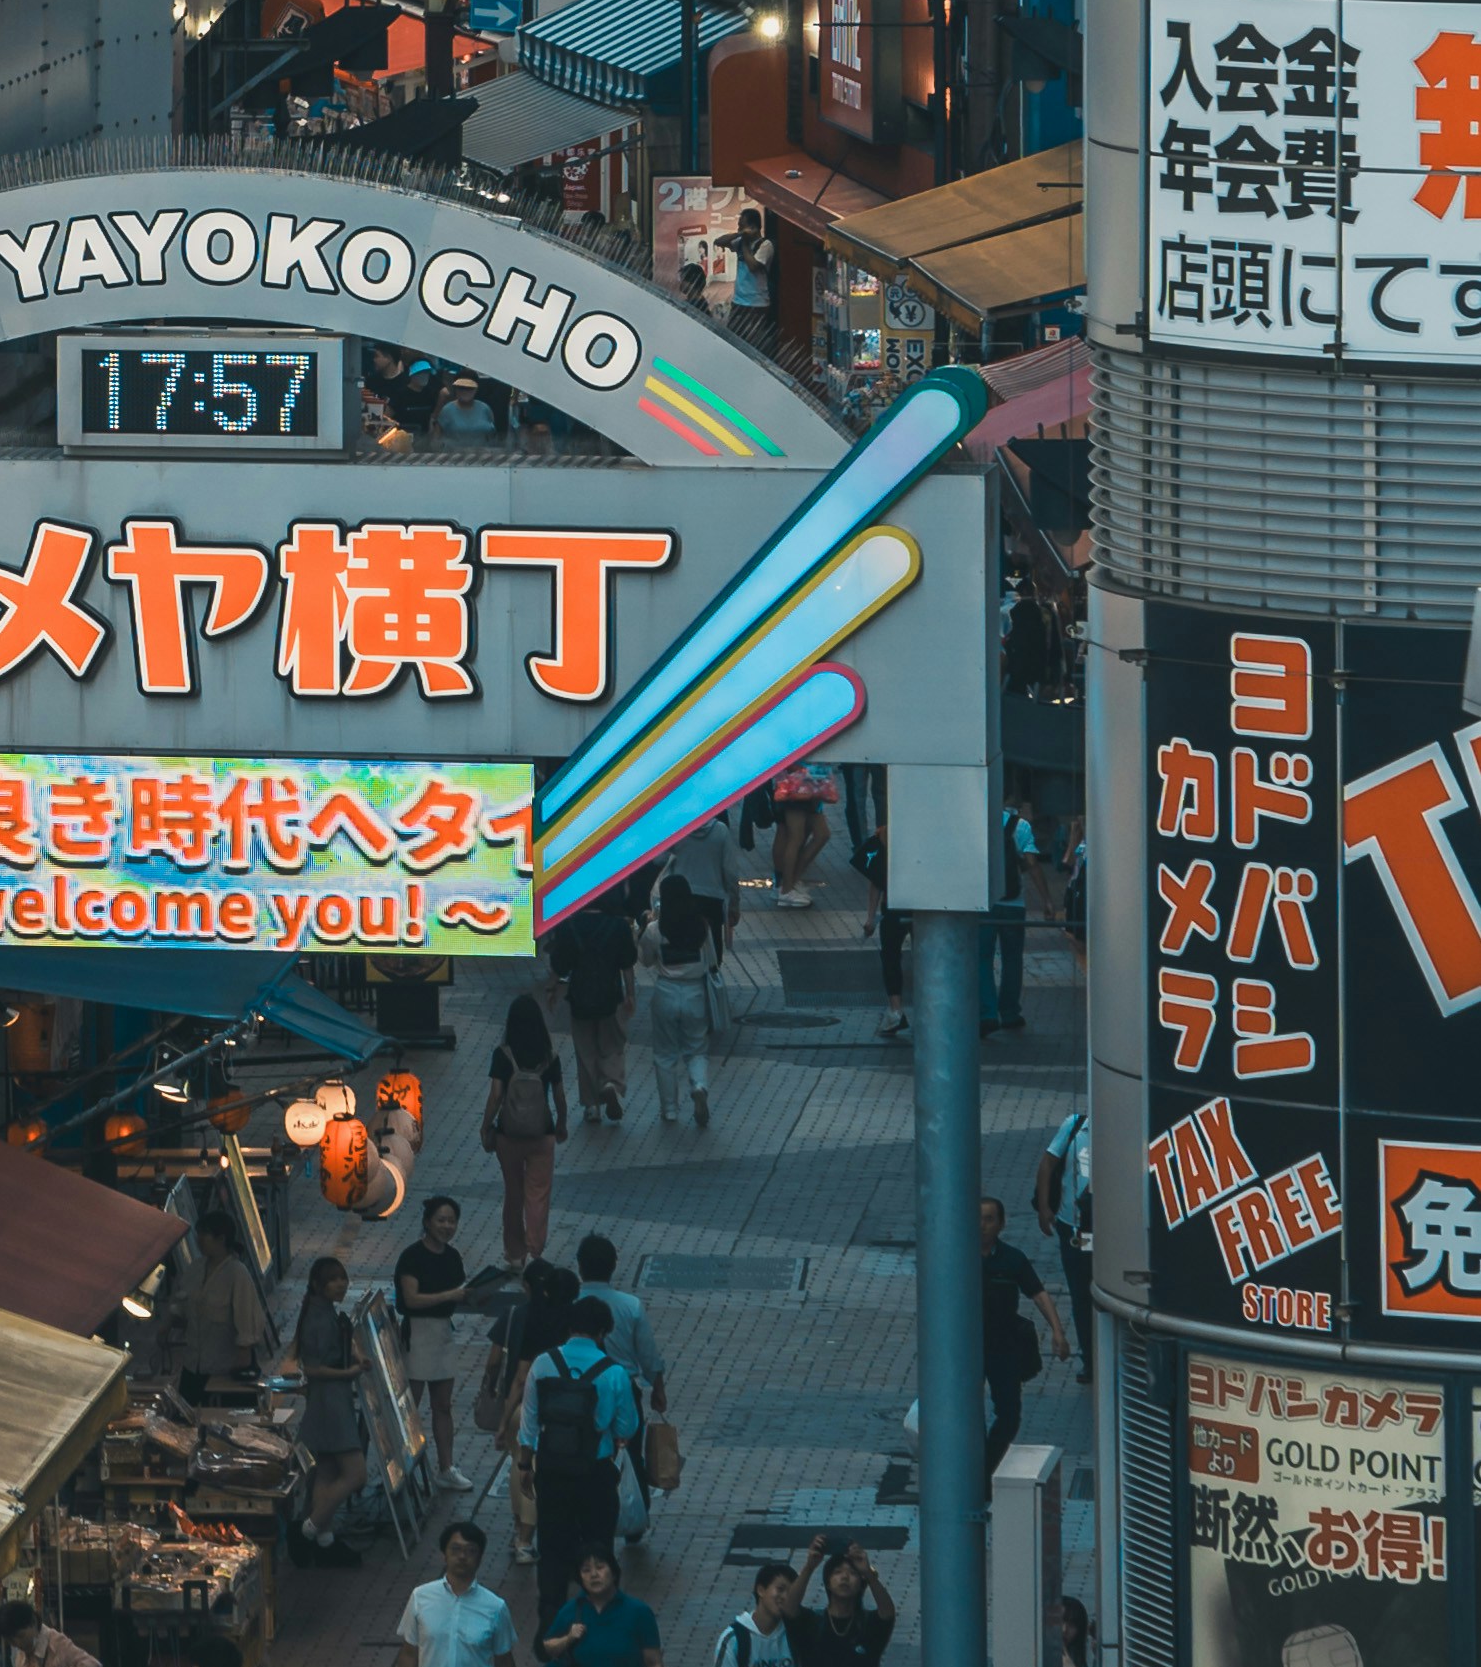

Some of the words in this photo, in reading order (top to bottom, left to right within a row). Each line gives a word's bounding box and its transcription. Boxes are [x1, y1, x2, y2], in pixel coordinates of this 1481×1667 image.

[1159, 20, 1362, 119] 入会金
[1159, 119, 1361, 225] 年会費
[97, 351, 312, 432] 17:57
[1226, 631, 1319, 1080] ヨドバシ
[270, 882, 425, 950] you!
[1157, 737, 1220, 1072] カメラ
[1147, 1096, 1257, 1231] TAX
[1209, 1151, 1343, 1286] FREE
[1241, 1280, 1333, 1332] STORE
[1189, 1364, 1445, 1436] ヨドバシカメラ
[1191, 1422, 1253, 1456] 他カード
[1207, 1451, 1236, 1476] より
[1265, 1436, 1341, 1472] GOLD
[1349, 1448, 1443, 1484] POINT
